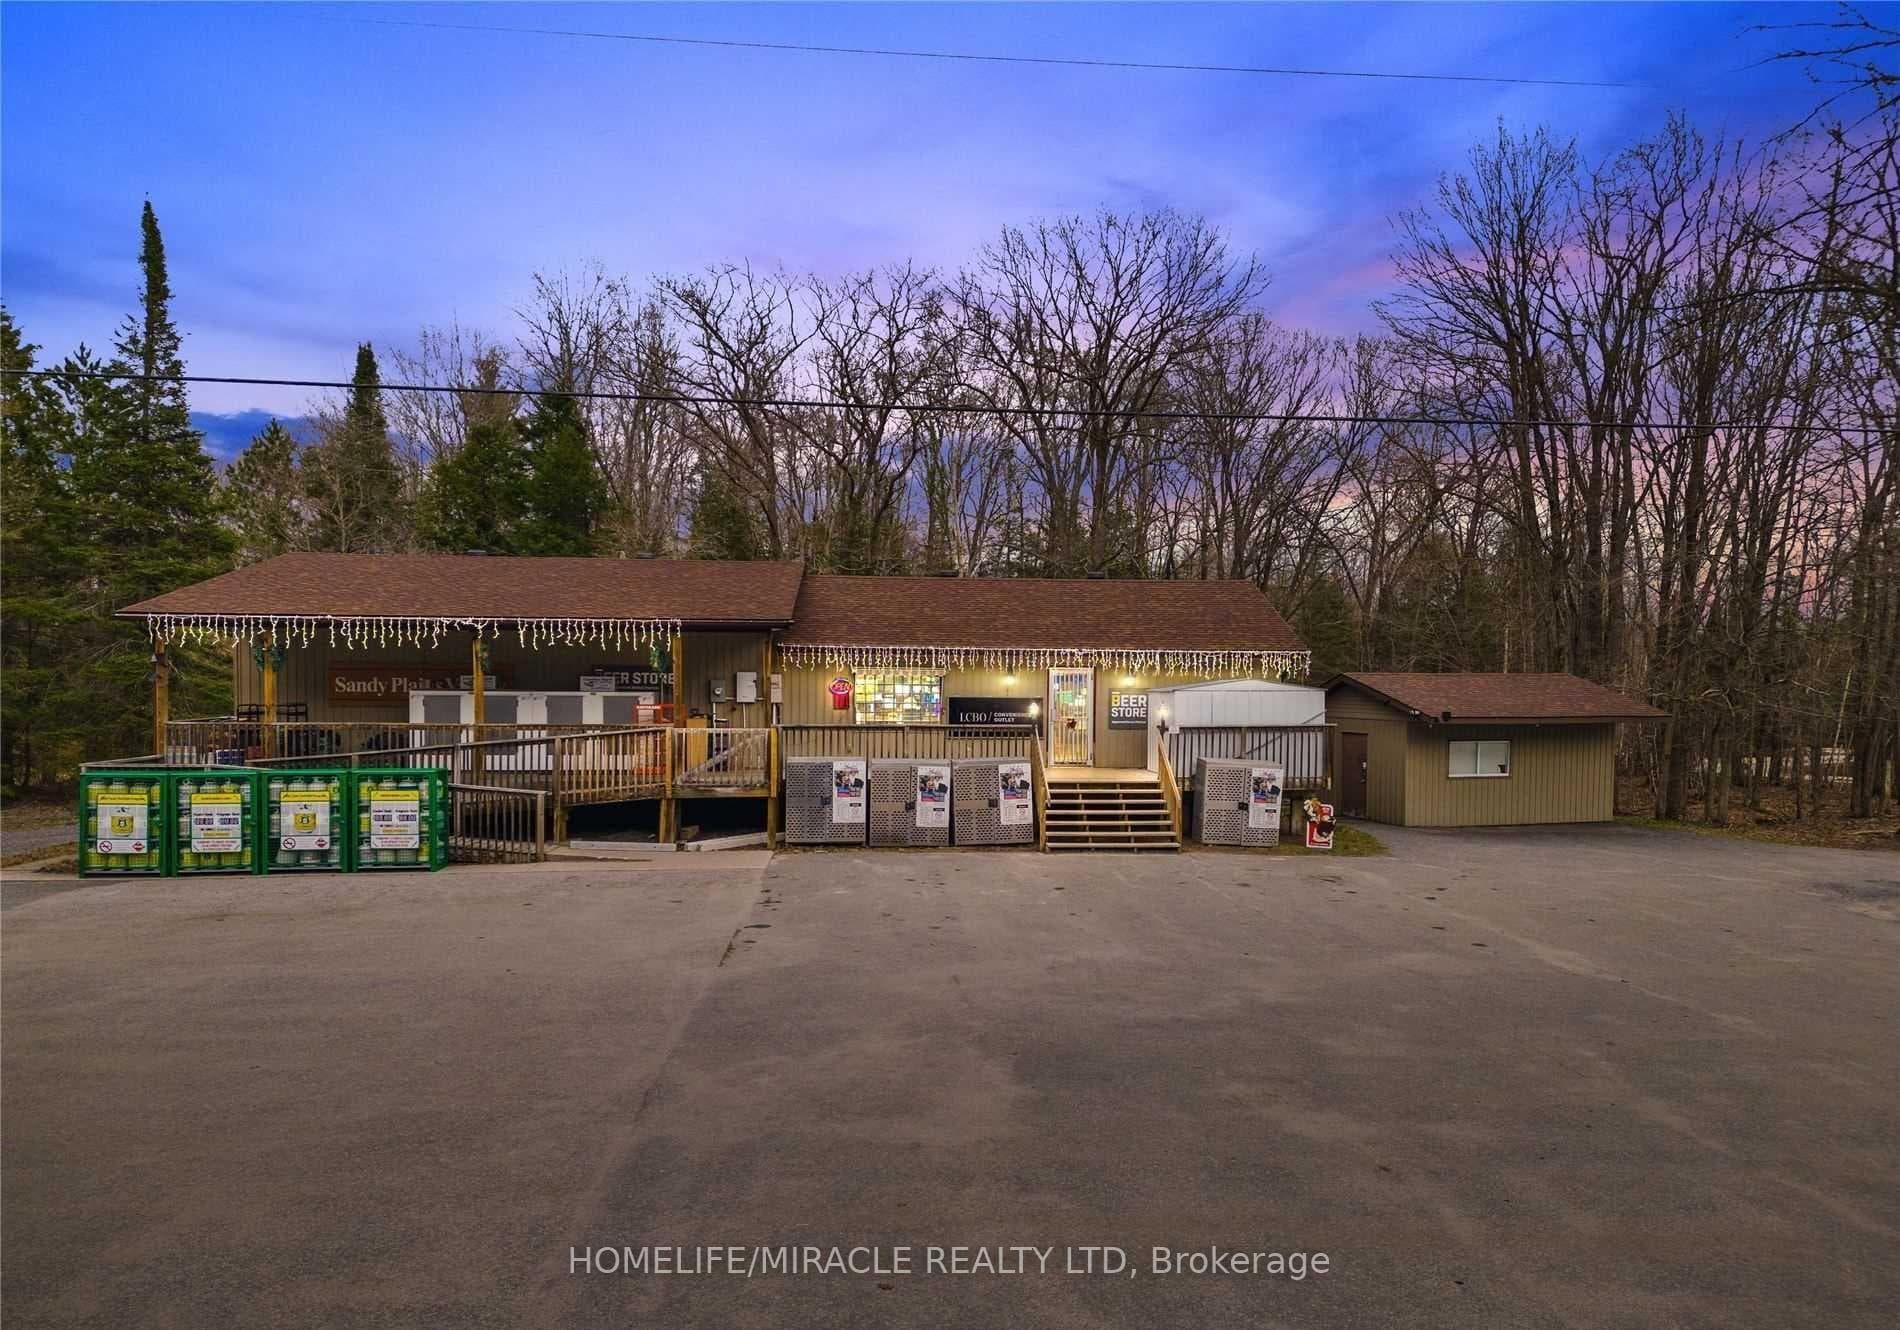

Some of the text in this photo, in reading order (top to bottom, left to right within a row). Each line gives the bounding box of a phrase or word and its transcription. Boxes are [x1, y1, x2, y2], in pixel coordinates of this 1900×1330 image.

[335, 677, 385, 696] Sandy
[1111, 692, 1147, 707] BEER
[960, 712, 987, 722] LCBO
[1111, 707, 1147, 717] STORE
